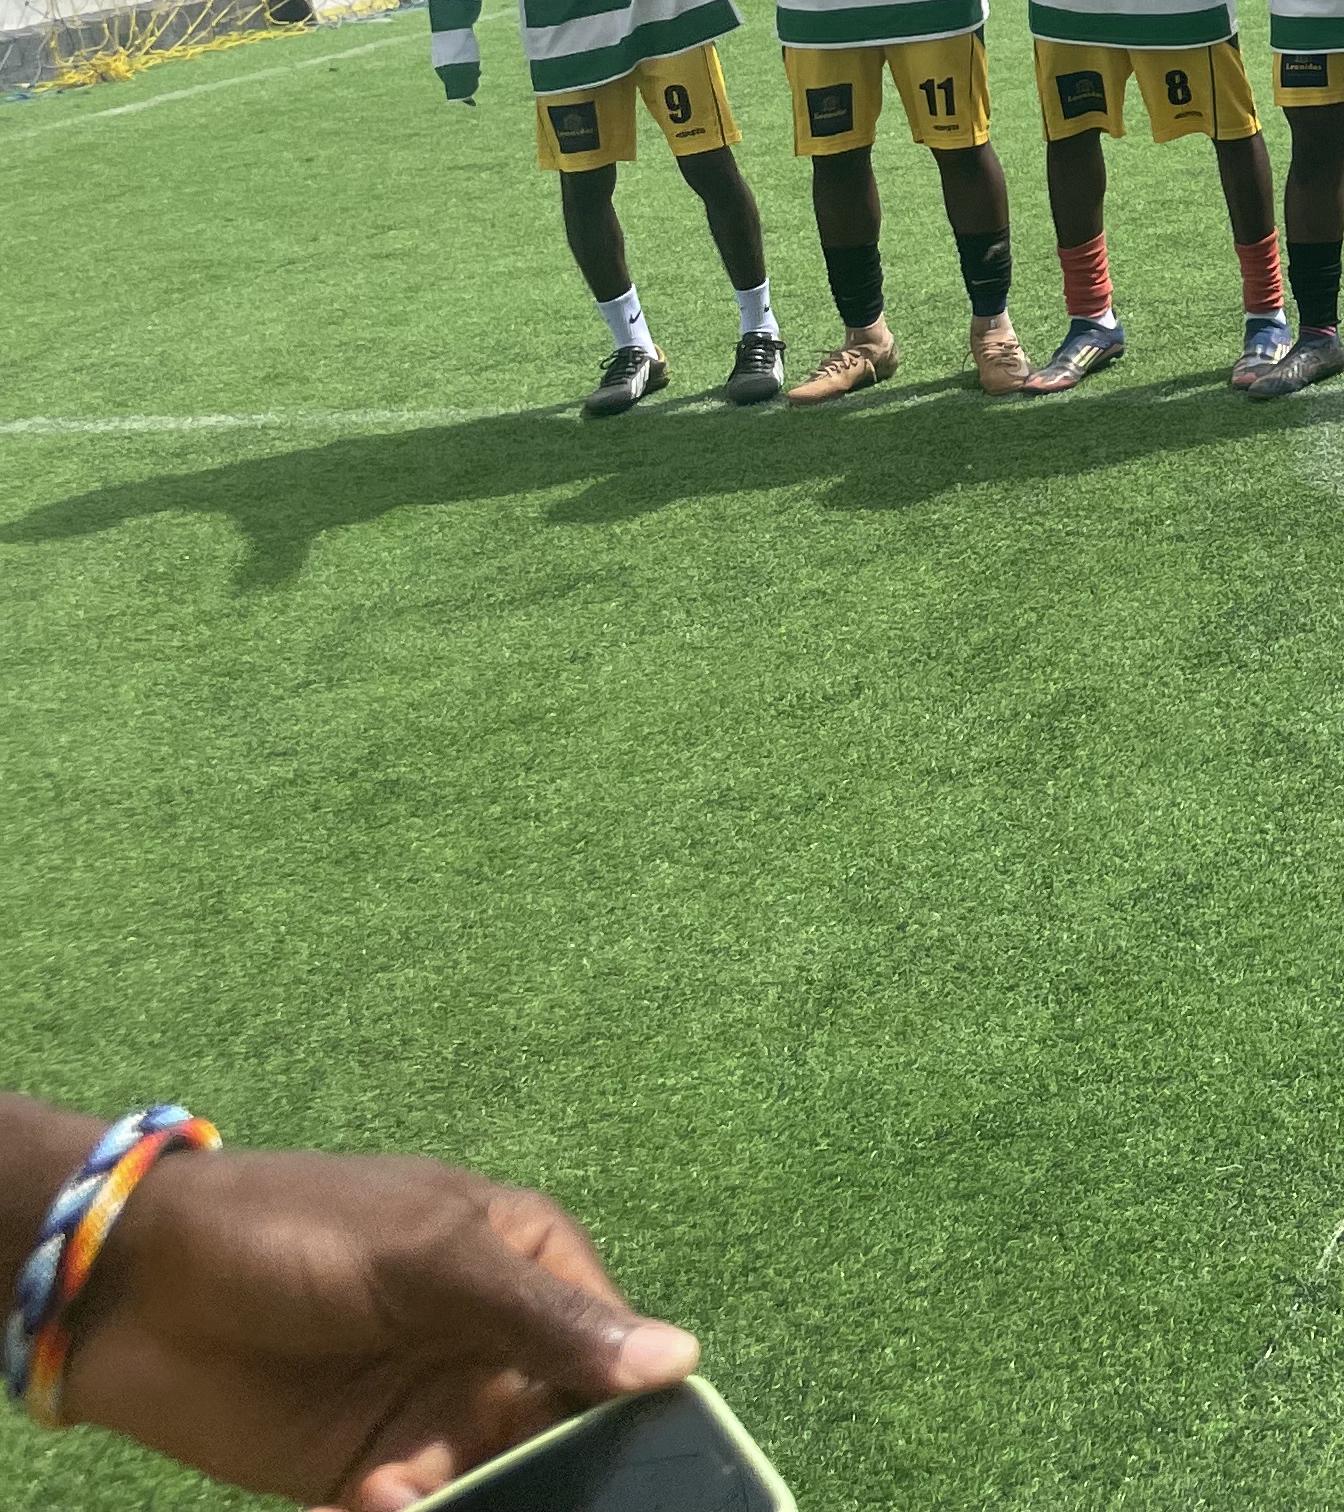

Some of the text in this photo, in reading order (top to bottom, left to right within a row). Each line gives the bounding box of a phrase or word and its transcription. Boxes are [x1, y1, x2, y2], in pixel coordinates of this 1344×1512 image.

[664, 84, 692, 124] 9
[919, 77, 956, 116] 11
[1165, 69, 1193, 106] 8
